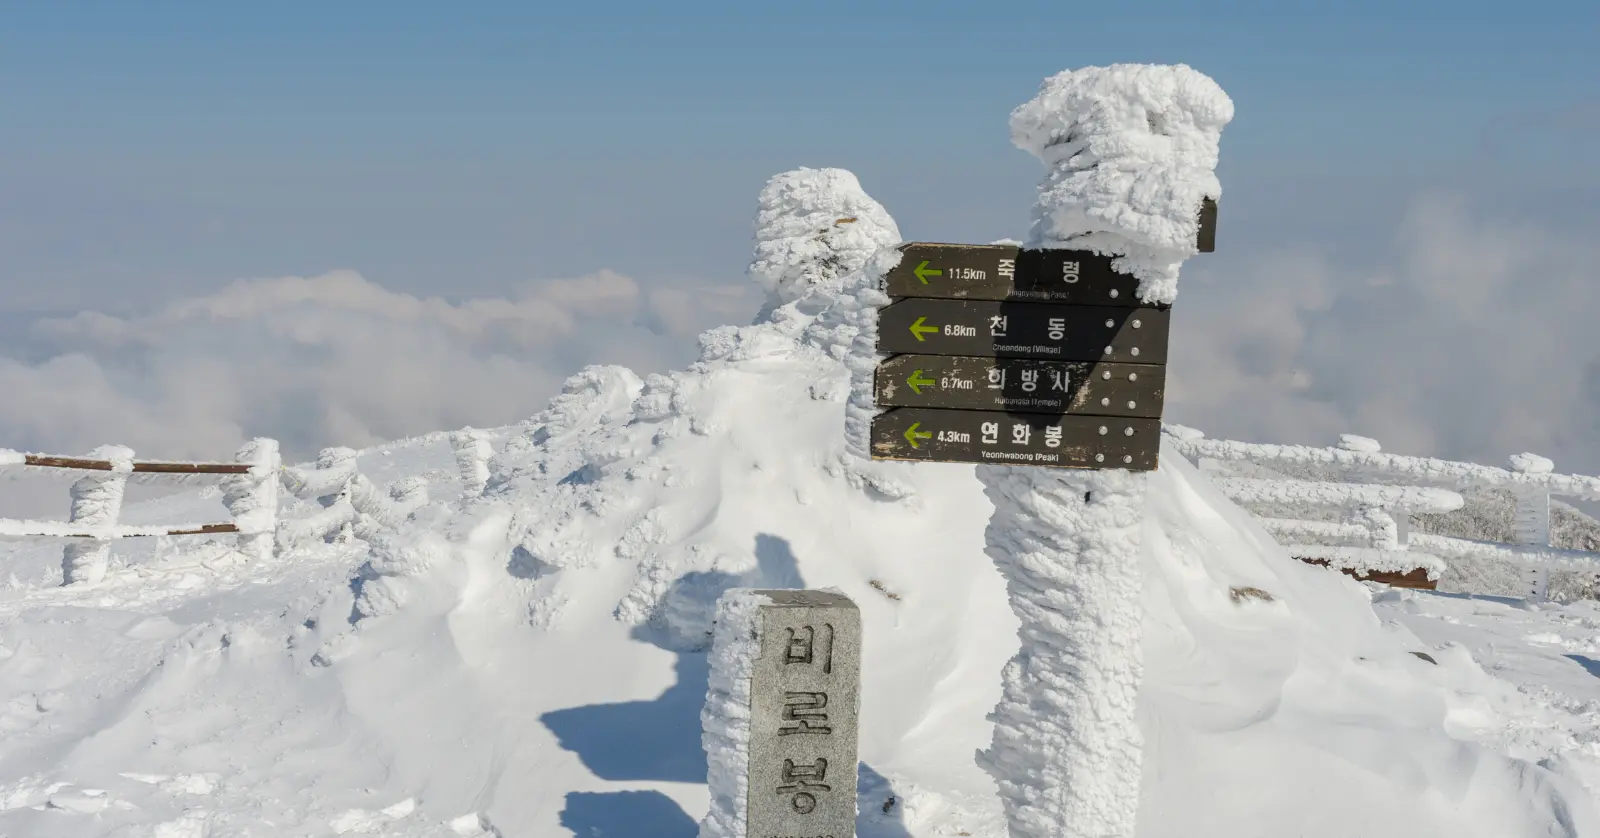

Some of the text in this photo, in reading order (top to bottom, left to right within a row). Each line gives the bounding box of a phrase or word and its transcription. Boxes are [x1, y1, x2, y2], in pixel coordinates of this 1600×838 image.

[948, 268, 986, 281] 11.5km
[944, 324, 976, 337] 6.8km
[992, 343, 1032, 354] Cheondong
[941, 377, 973, 390] 6.7km
[937, 430, 970, 443] 4.3km
[981, 450, 1034, 461] Yeonhwabong
